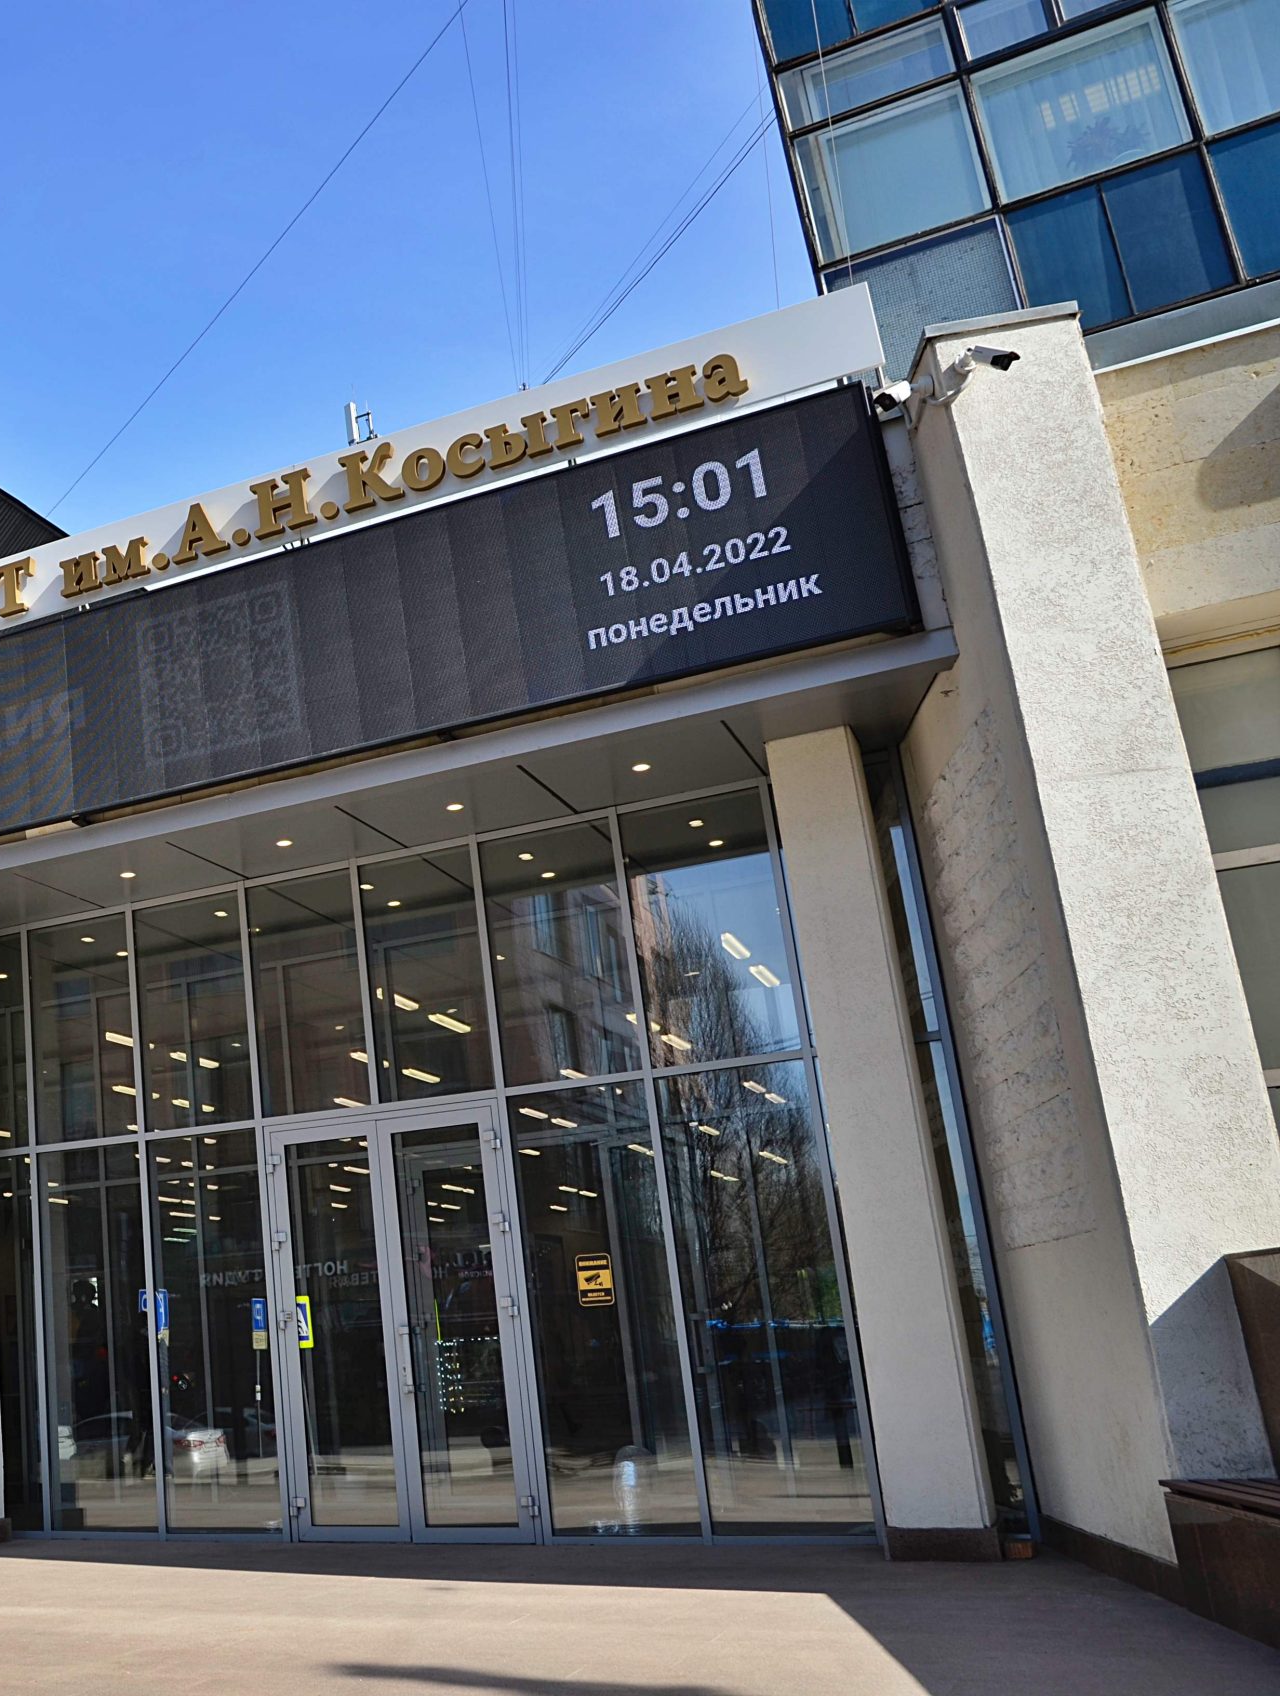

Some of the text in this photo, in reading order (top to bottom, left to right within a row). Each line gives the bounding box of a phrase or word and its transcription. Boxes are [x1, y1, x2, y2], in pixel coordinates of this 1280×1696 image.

[591, 448, 768, 539] 15:01
[600, 526, 792, 597] 18.04.2022
[588, 573, 824, 650] понедельник
